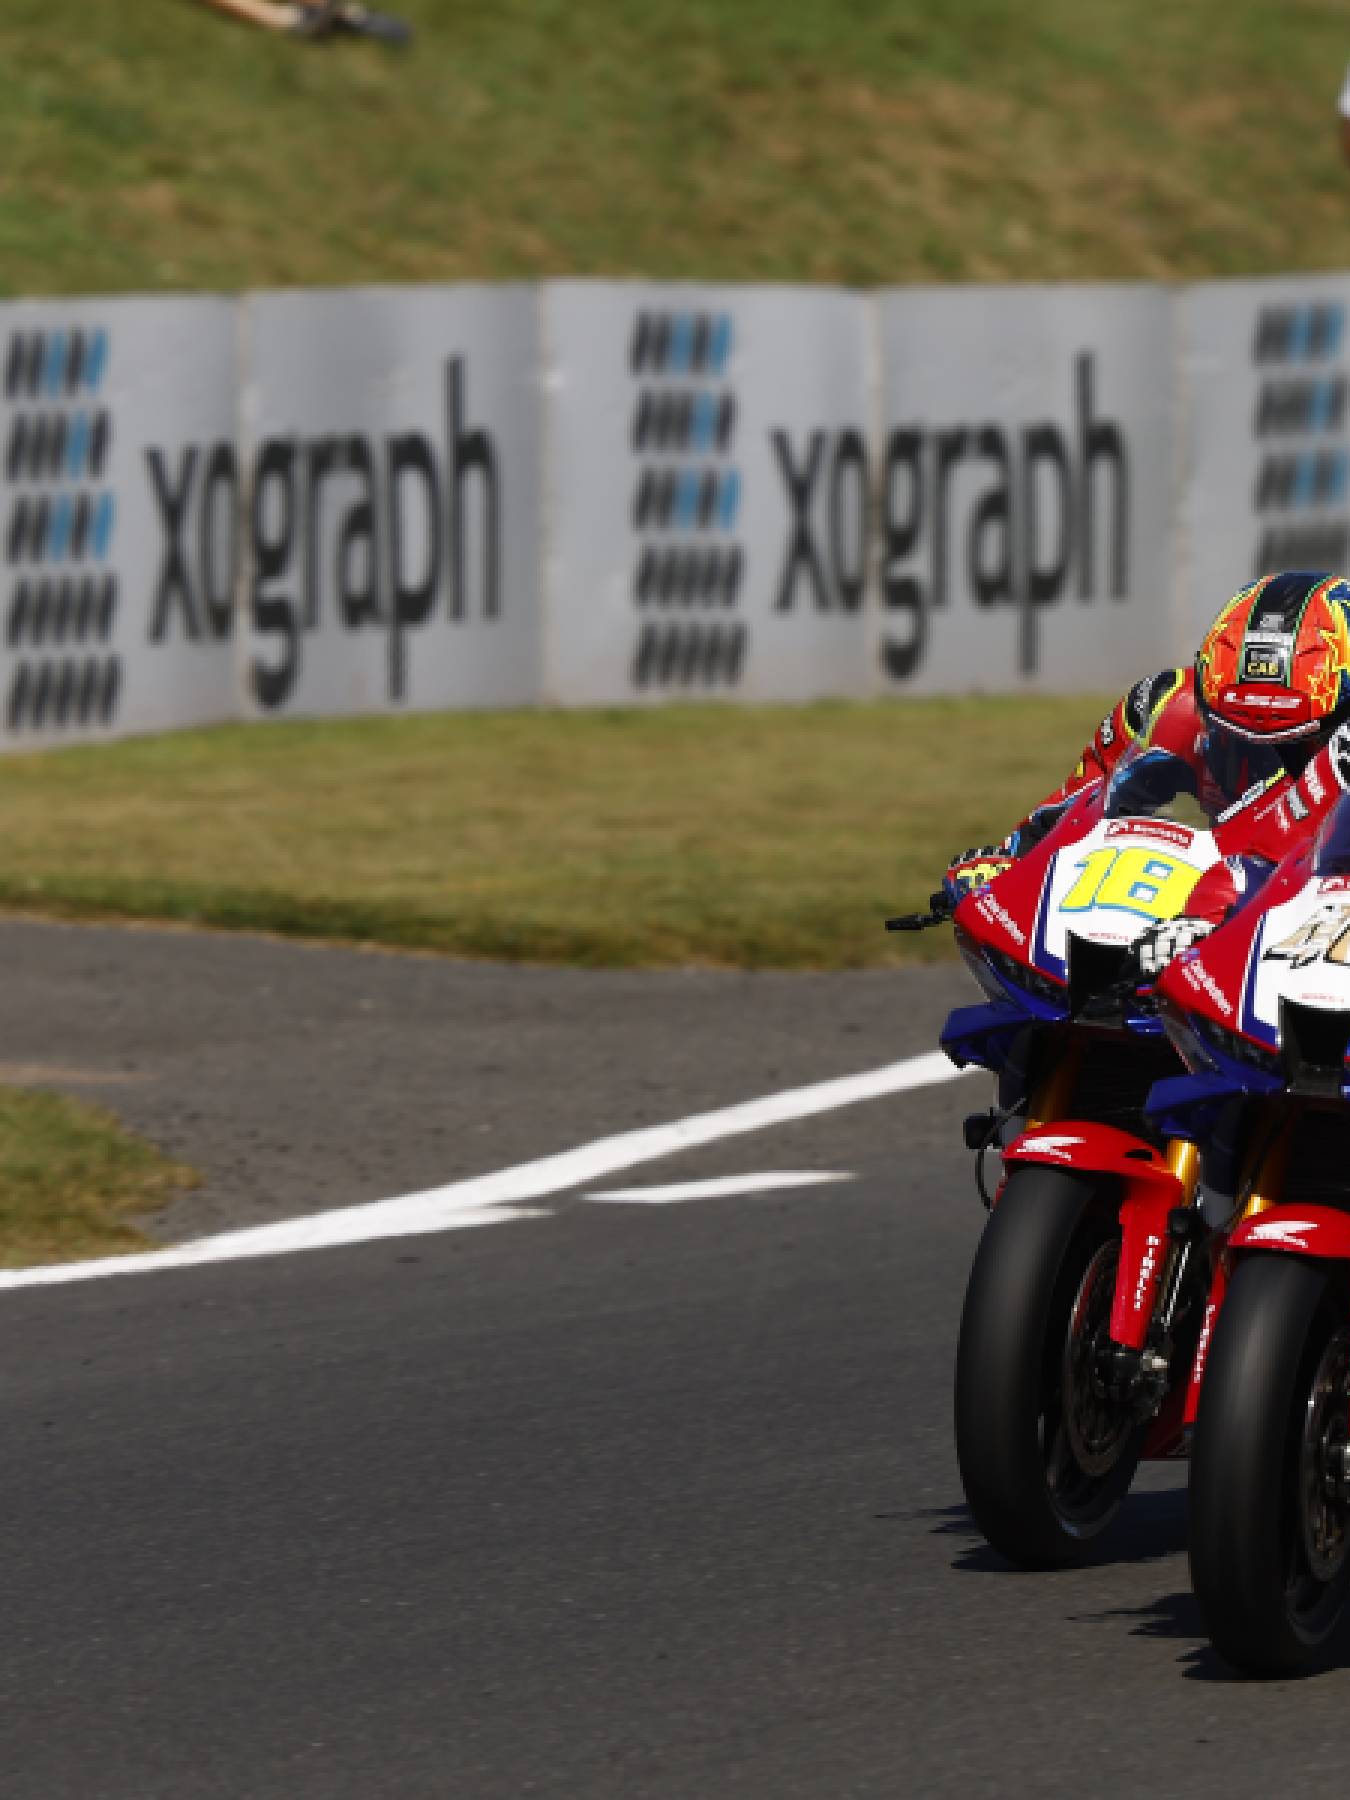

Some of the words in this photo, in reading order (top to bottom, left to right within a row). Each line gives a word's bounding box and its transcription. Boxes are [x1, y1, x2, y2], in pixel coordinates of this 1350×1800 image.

[142, 353, 502, 709] xograph
[768, 350, 1129, 681] xograph
[1058, 846, 1204, 923] 18
